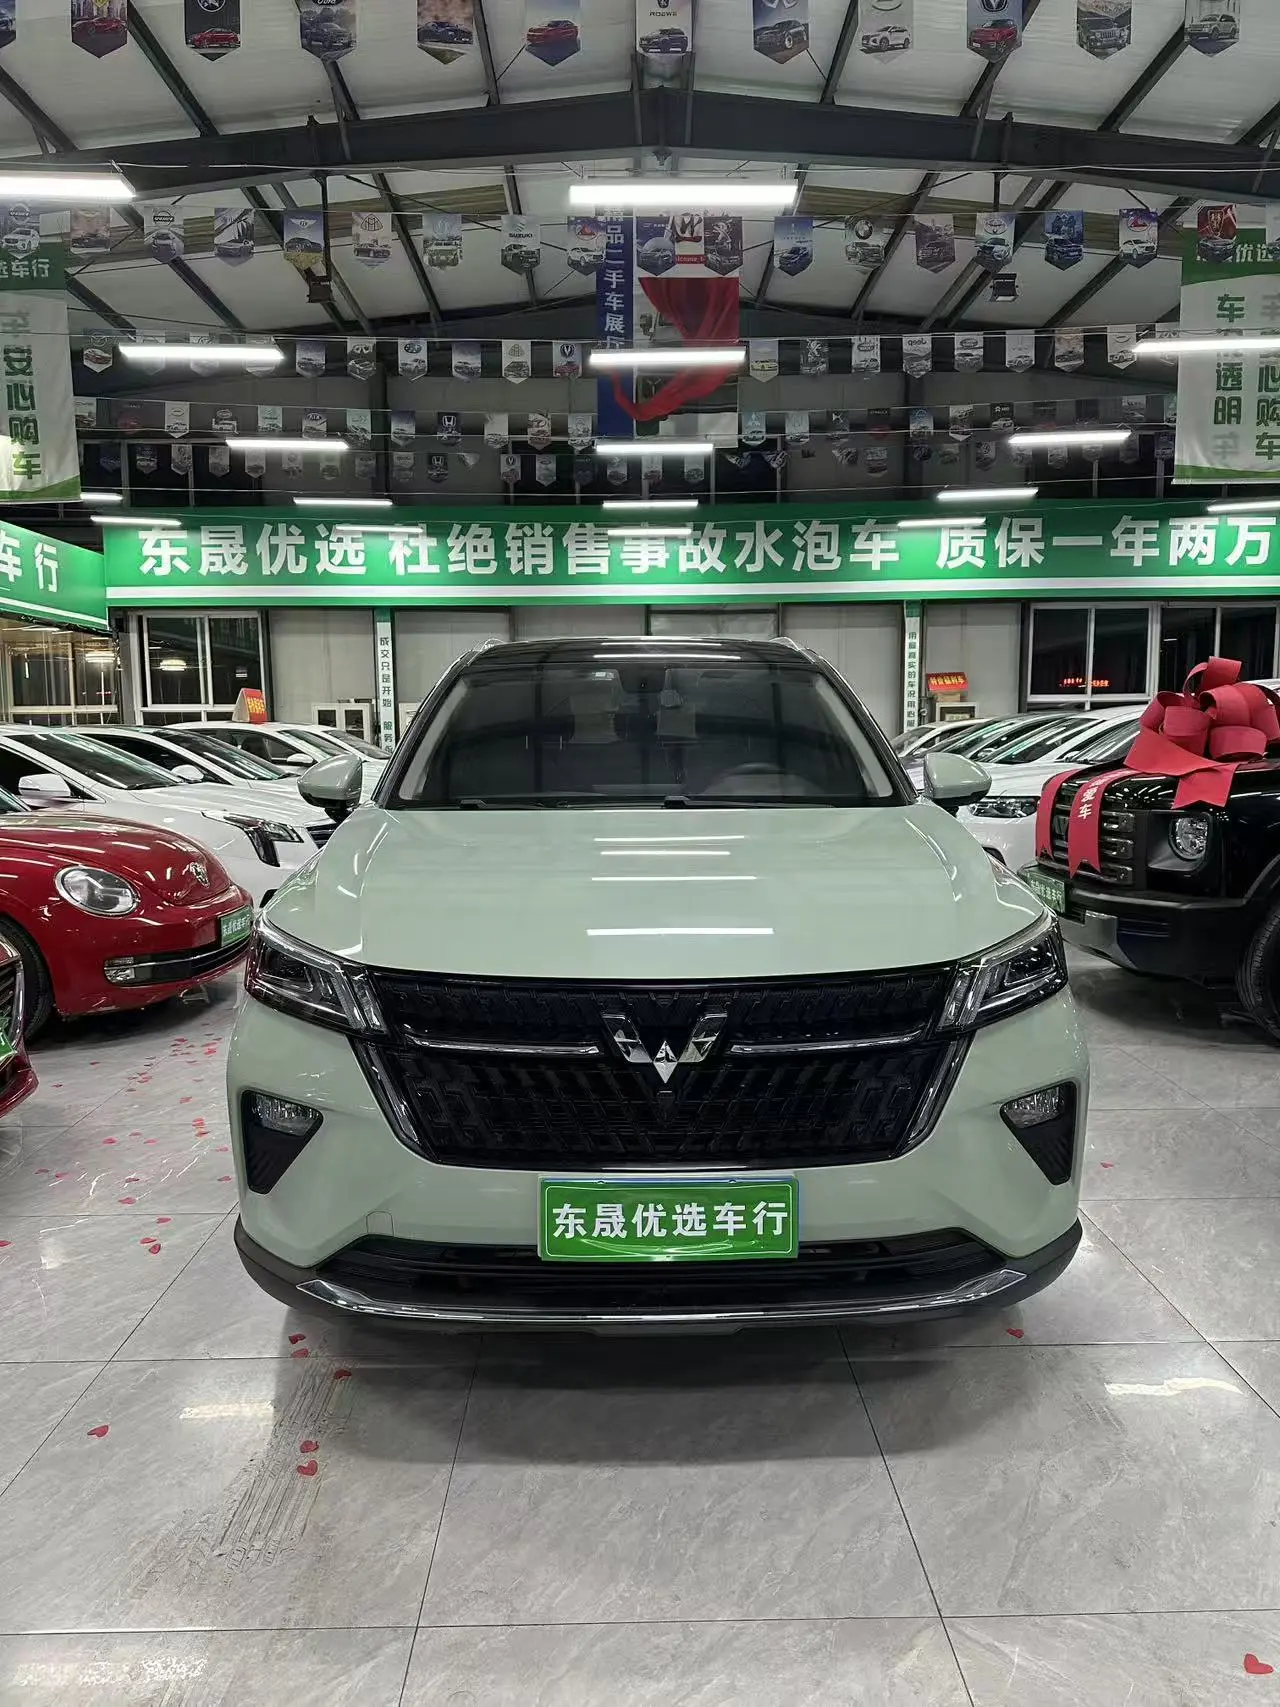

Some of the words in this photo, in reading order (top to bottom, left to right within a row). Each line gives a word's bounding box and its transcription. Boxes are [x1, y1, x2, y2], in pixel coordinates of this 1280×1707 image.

[1214, 293, 1245, 424] 车透明
[0, 529, 58, 592] 车行
[138, 522, 367, 575] 东晟优选
[389, 519, 900, 576] 杜绝销售事故水泡车
[935, 516, 1277, 569] 质保一年两万
[379, 636, 392, 708] 成交只是开始
[552, 1201, 788, 1239] 东晟优选车行
